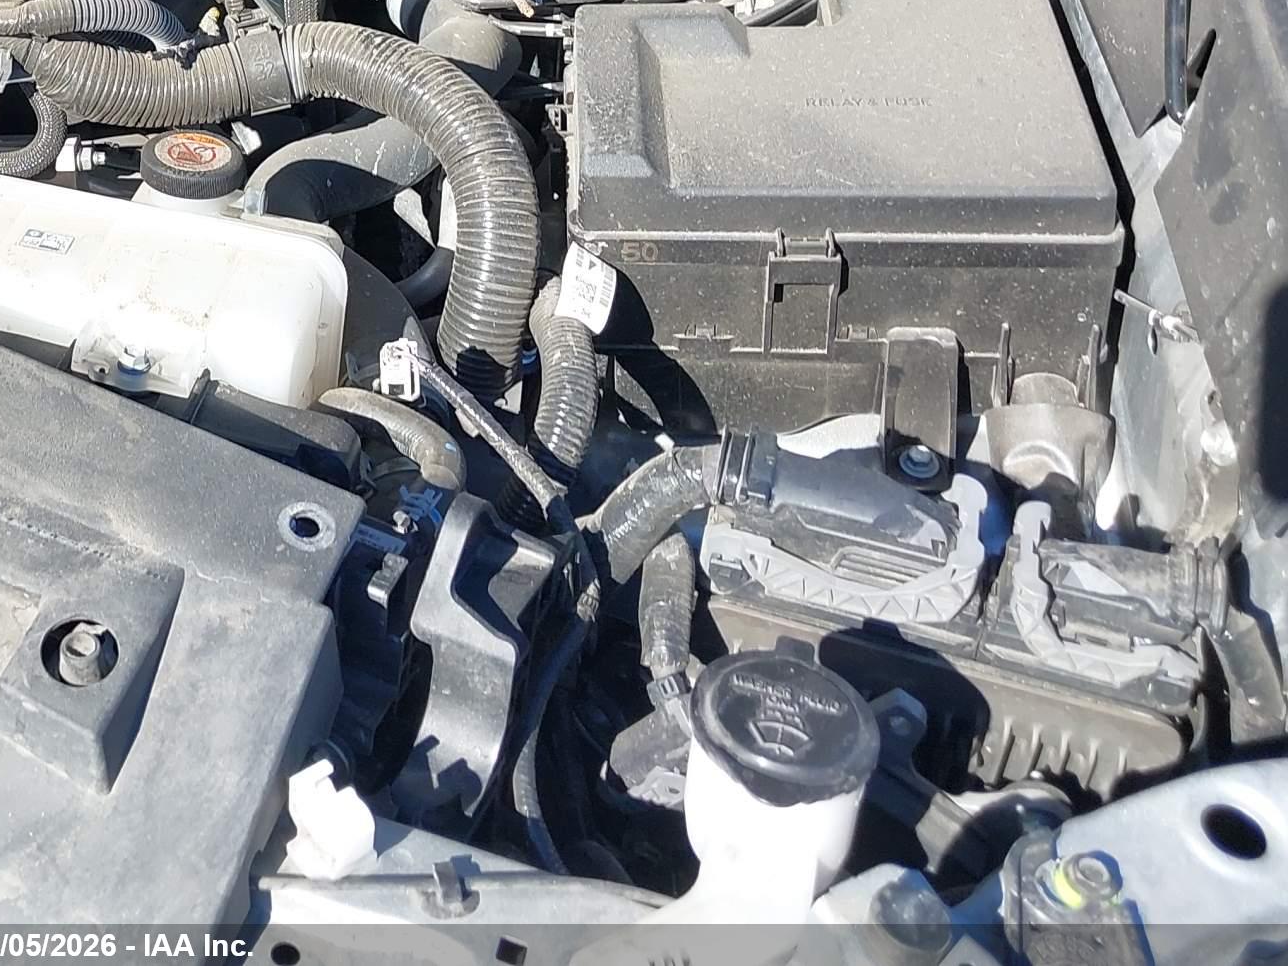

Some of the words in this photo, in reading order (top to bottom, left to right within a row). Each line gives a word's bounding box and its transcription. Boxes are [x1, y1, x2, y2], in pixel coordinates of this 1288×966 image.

[805, 97, 863, 107] RELAY
[867, 97, 877, 107] &
[884, 97, 932, 107] FUSE
[621, 242, 659, 261] 50
[732, 673, 792, 699] WASHER
[799, 690, 841, 714] FLUID
